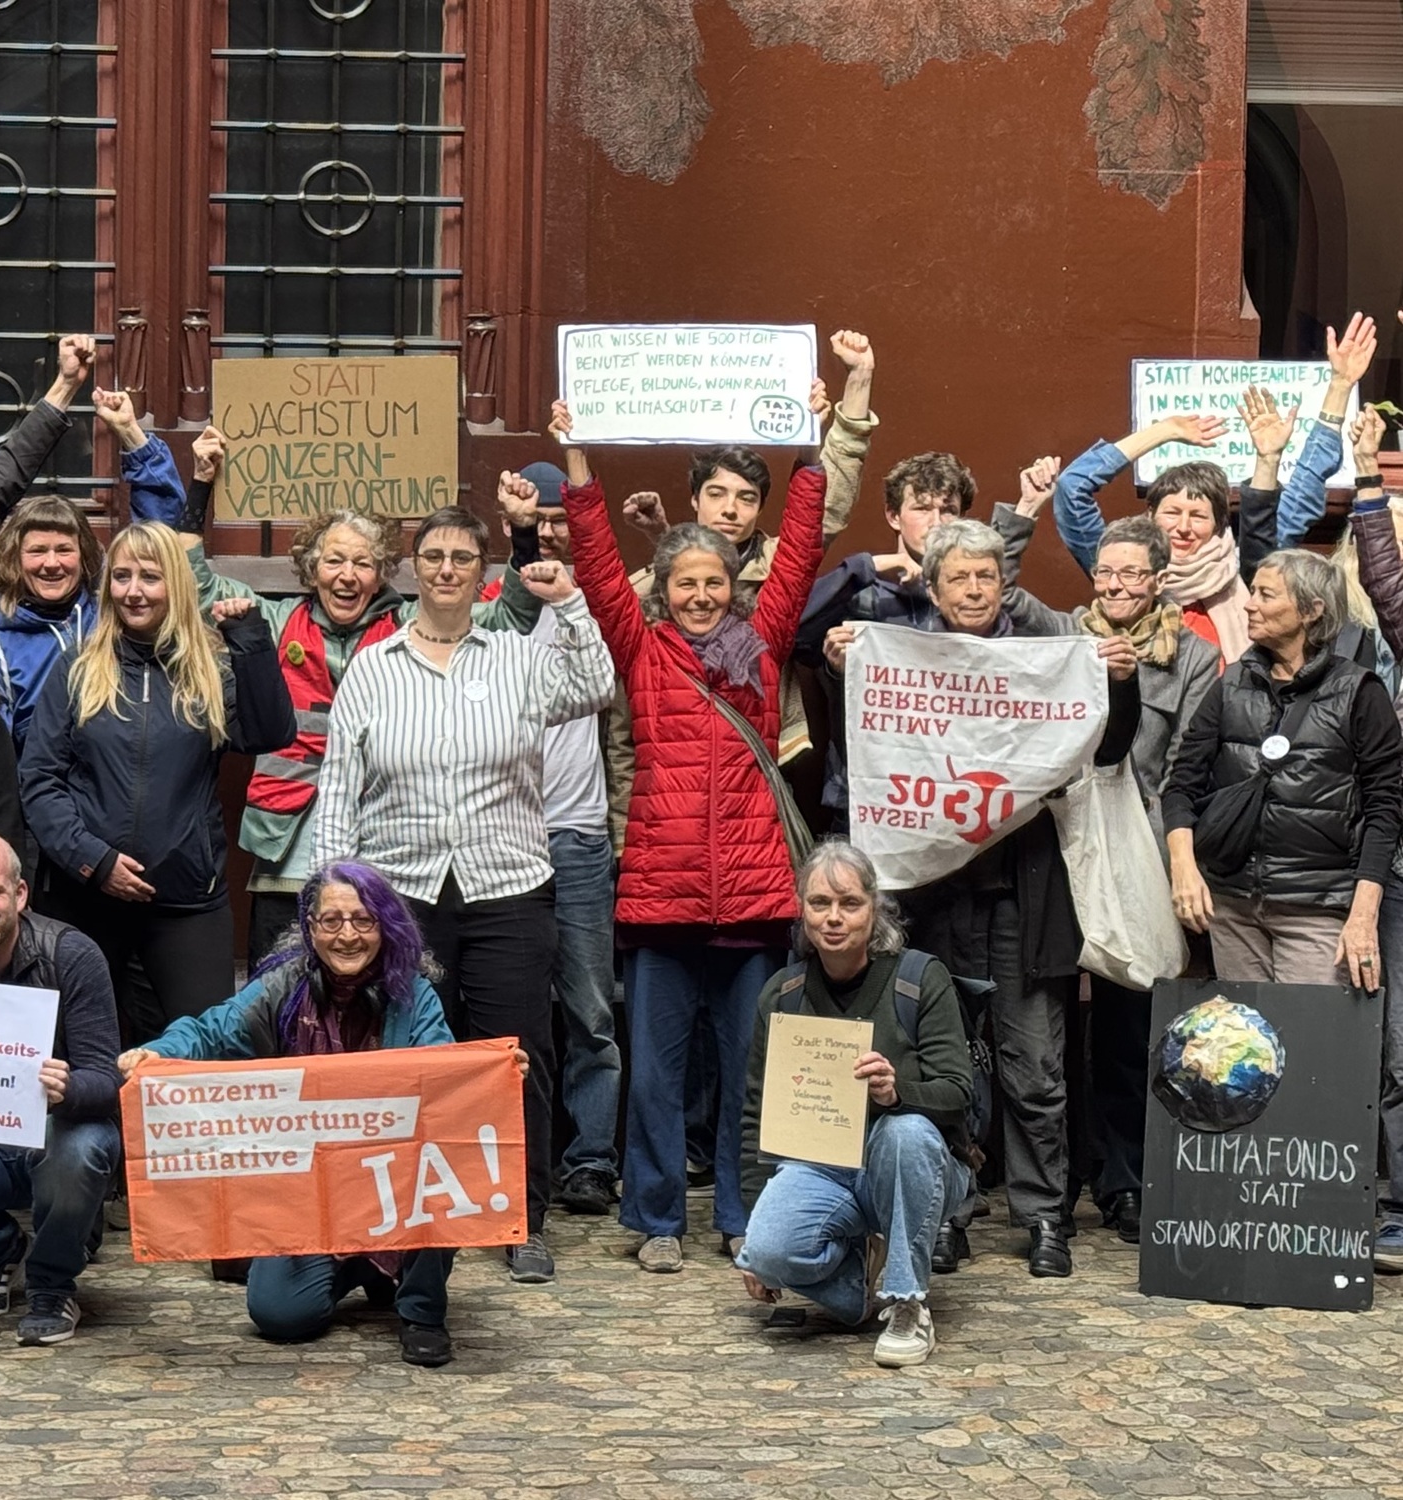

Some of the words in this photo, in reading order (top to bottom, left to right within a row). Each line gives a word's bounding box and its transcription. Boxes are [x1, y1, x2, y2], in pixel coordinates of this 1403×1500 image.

[573, 333, 603, 349] WIR
[610, 332, 667, 347] WISSEN
[675, 332, 700, 347] WIE
[708, 331, 736, 345] 500
[576, 352, 639, 370] BENUTZT
[646, 353, 703, 367] WERDEN
[290, 363, 385, 397] STATT
[573, 378, 634, 396] PFLEGE,
[705, 378, 786, 392] WOHNRAUM
[1145, 365, 1192, 385] STATT
[1202, 365, 1308, 386] HOCHBEZAHLTE
[577, 400, 605, 417] UND
[762, 400, 793, 410] TAX
[1149, 394, 1168, 411] IN
[1174, 393, 1202, 410] DEN
[1209, 391, 1303, 410] KONNEN
[222, 400, 419, 441] WACHSTUM
[759, 420, 792, 433] RICH
[768, 412, 795, 421] THE
[224, 442, 395, 488] KONZERN-
[225, 475, 448, 518] VERANTWORTUNG
[145, 1081, 288, 1107] Konzern-
[147, 1107, 405, 1140] verantwortungs-
[150, 1146, 297, 1173] initiative
[1176, 1133, 1359, 1182] KLIMAFONDS
[360, 1123, 510, 1237] JA!
[1239, 1181, 1305, 1208] STATT
